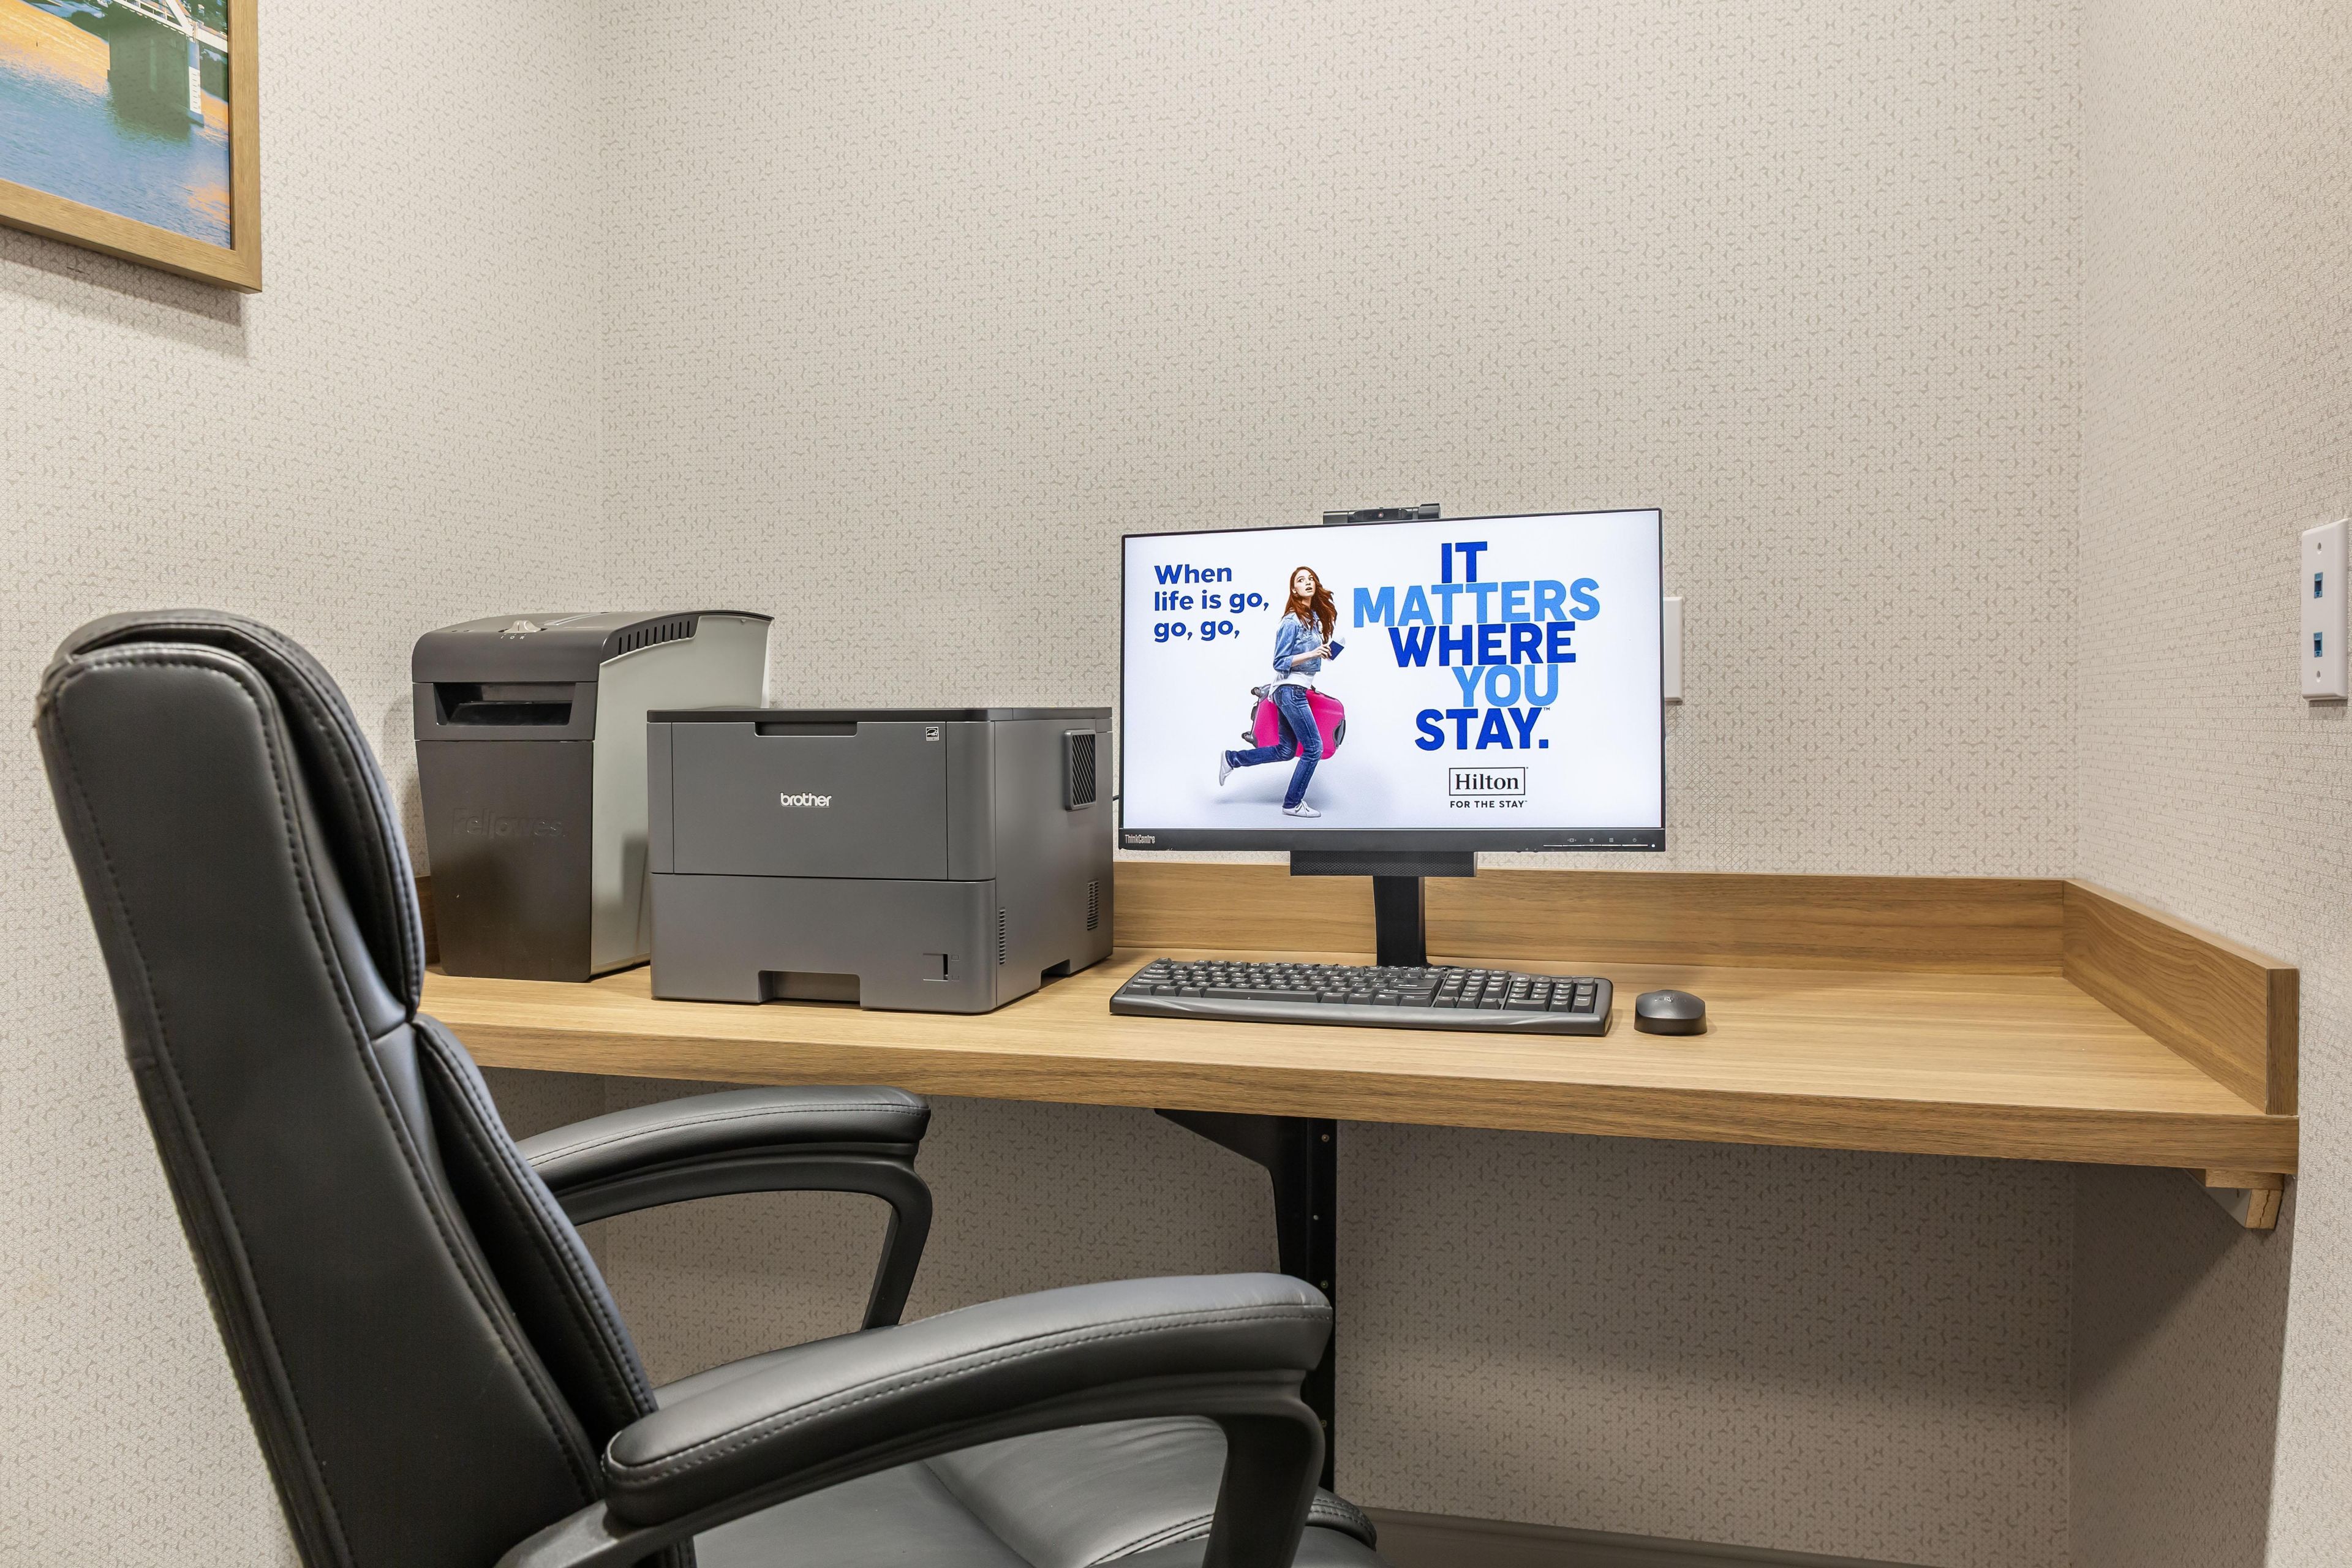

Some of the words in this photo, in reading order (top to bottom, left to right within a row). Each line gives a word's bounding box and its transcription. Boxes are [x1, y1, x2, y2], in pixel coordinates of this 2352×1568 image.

[1154, 564, 1232, 585] When
[1441, 541, 1488, 584] IT
[1154, 589, 1195, 612] life
[1202, 589, 1222, 609] is
[1229, 592, 1269, 614] go,
[1354, 577, 1600, 628] MATTERS
[1153, 622, 1193, 643] go,
[1200, 620, 1240, 642] go,
[1388, 621, 1576, 668] WHERE
[1452, 664, 1558, 708] YOU
[1455, 774, 1519, 790] Hilton
[780, 793, 832, 807] brother
[1125, 834, 1156, 844] ThinkCentre
